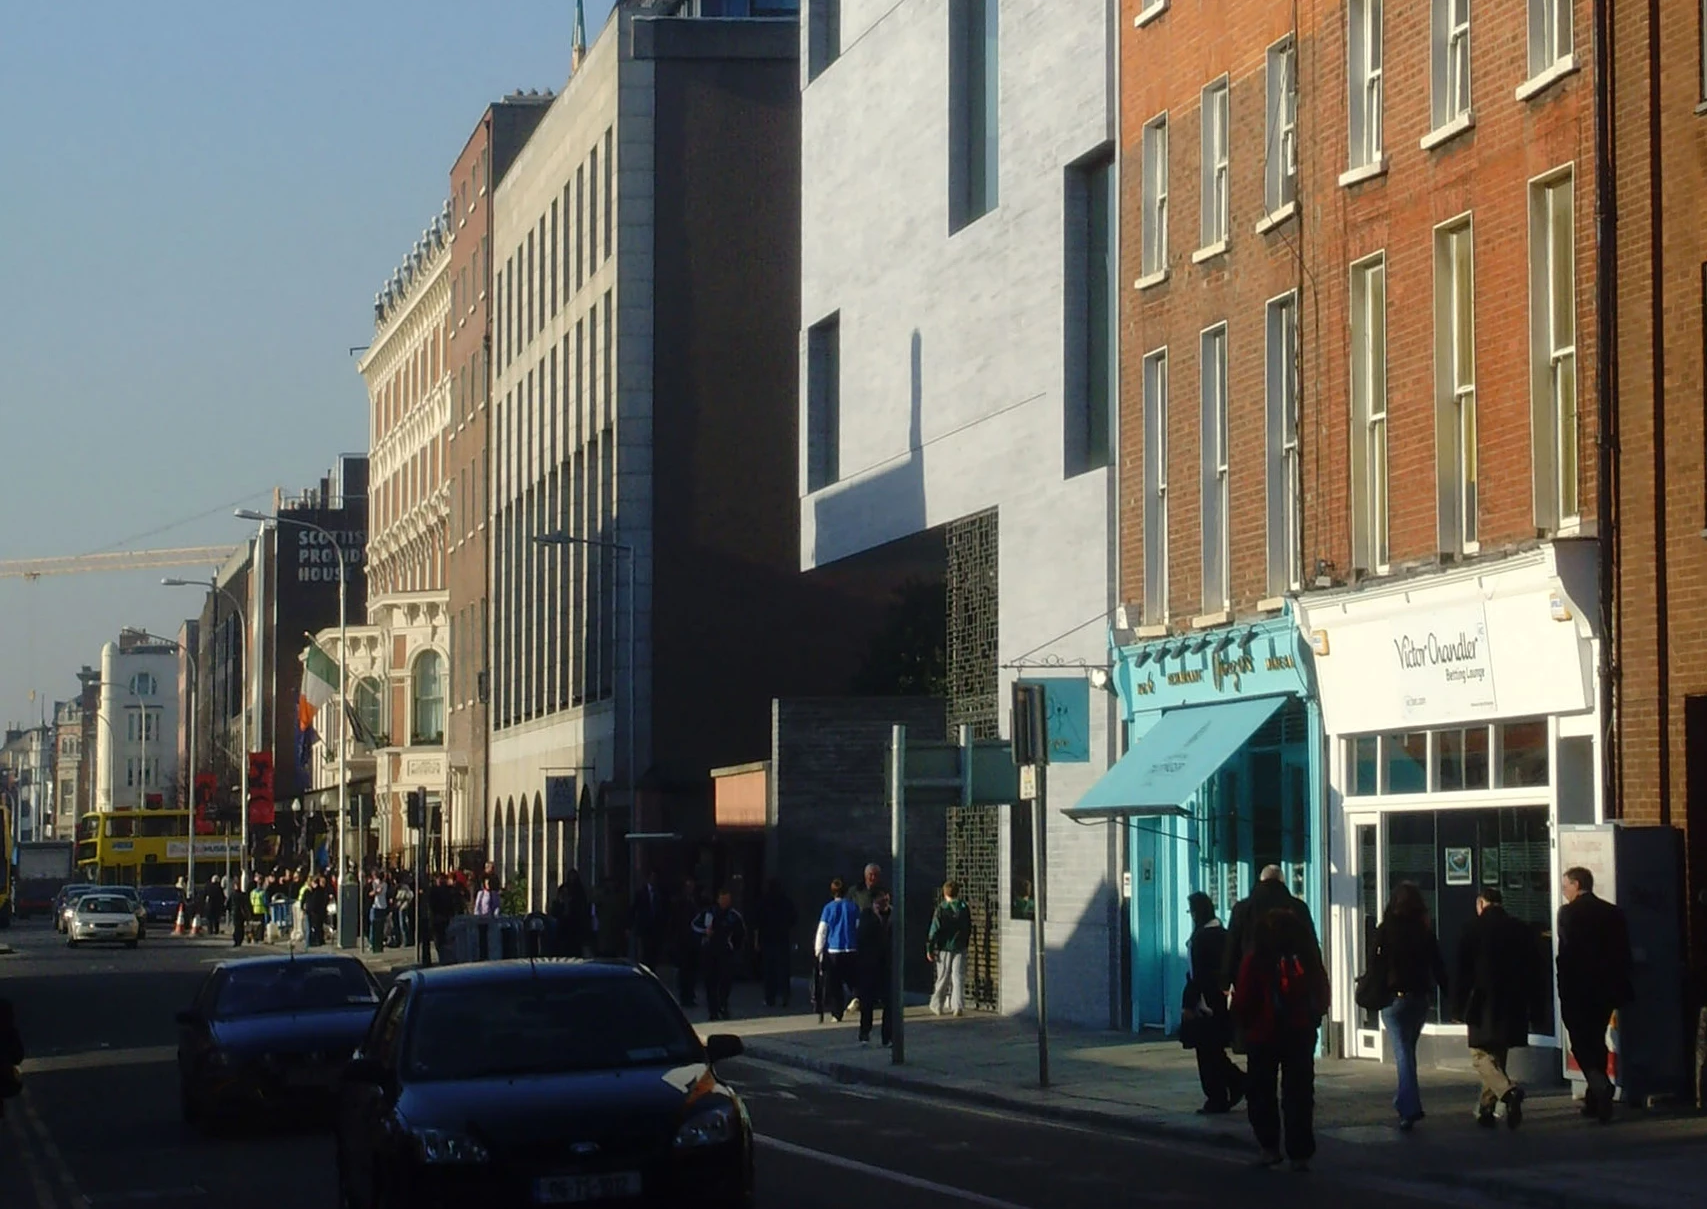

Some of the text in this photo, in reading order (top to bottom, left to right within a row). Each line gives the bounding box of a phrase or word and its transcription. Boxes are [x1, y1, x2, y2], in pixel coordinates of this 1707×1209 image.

[299, 548, 367, 563] PROID
[298, 567, 351, 581] HOUSE
[1394, 634, 1427, 670] Victor
[1428, 631, 1478, 665] Chandler
[1445, 668, 1466, 684] Betting
